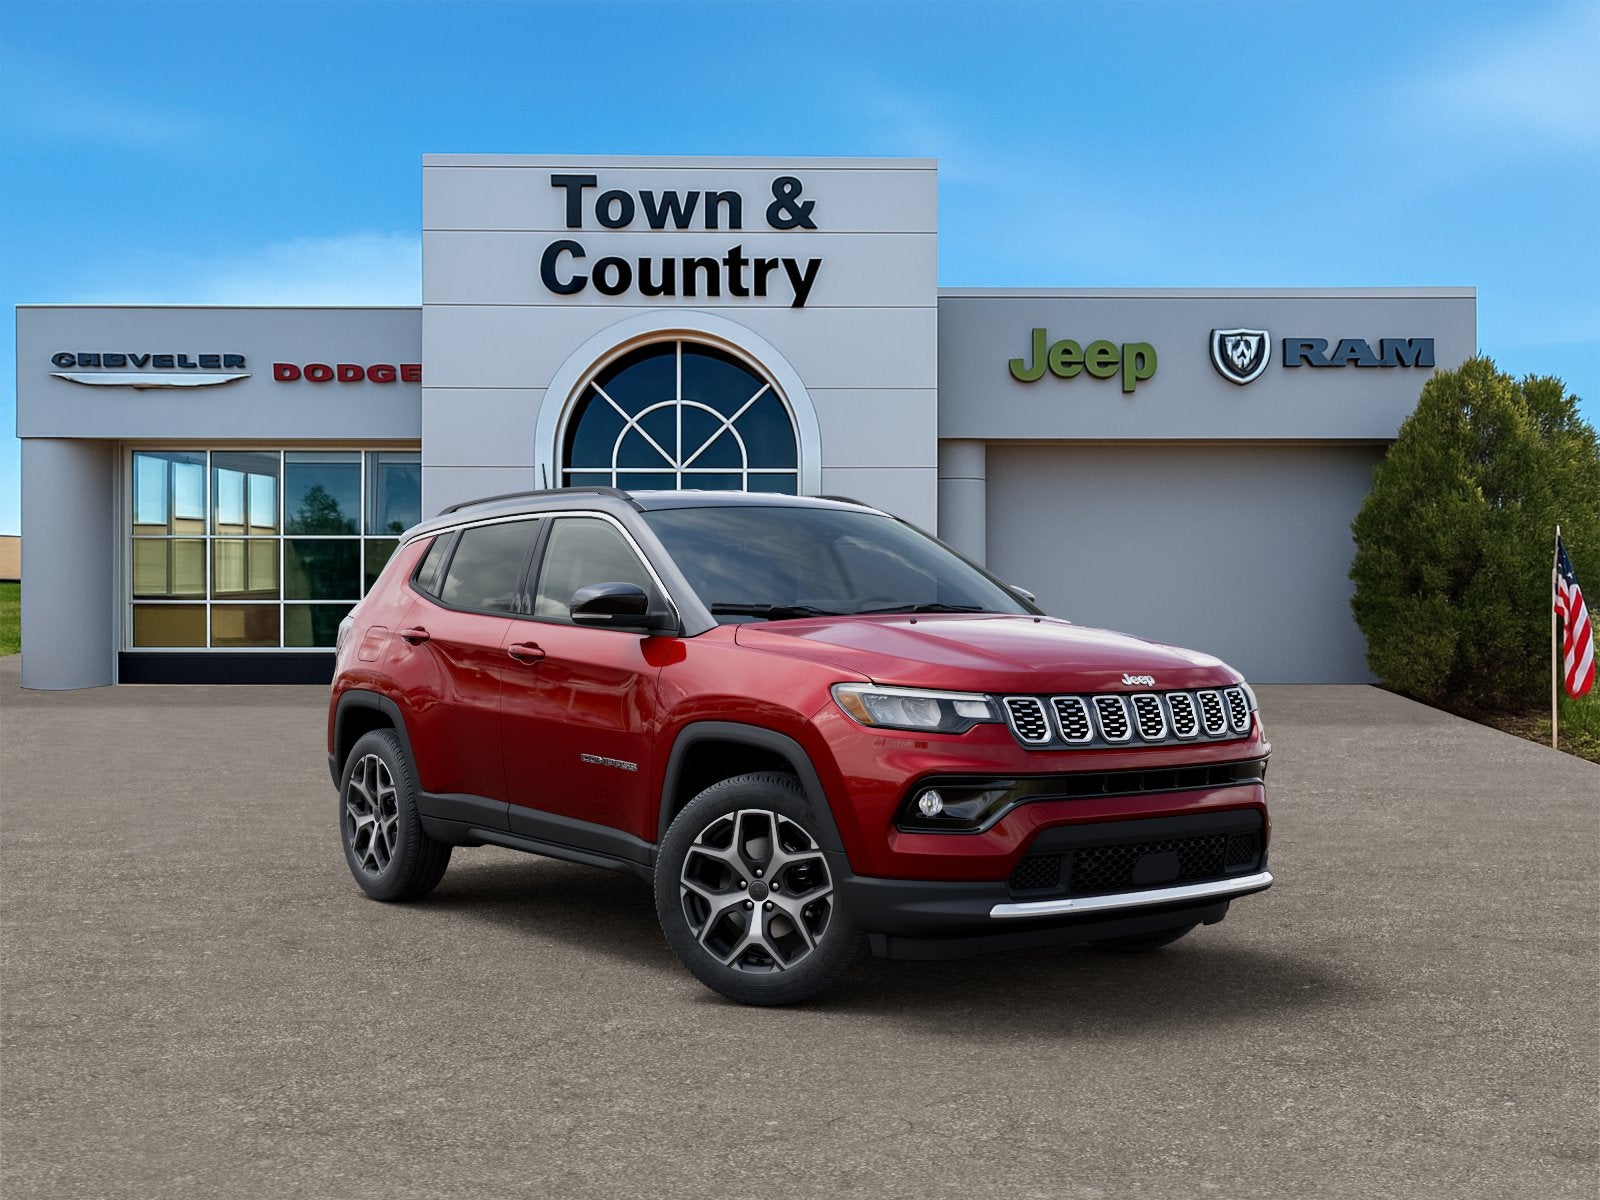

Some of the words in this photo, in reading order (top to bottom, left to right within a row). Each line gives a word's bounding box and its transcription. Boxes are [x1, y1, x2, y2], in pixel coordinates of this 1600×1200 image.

[550, 174, 742, 229] Town
[765, 175, 818, 230] &
[540, 239, 822, 308] Country
[273, 362, 422, 383] DODGE
[1009, 328, 1157, 393] Jeep
[1282, 338, 1436, 368] RAM
[1121, 673, 1156, 687] Jeep
